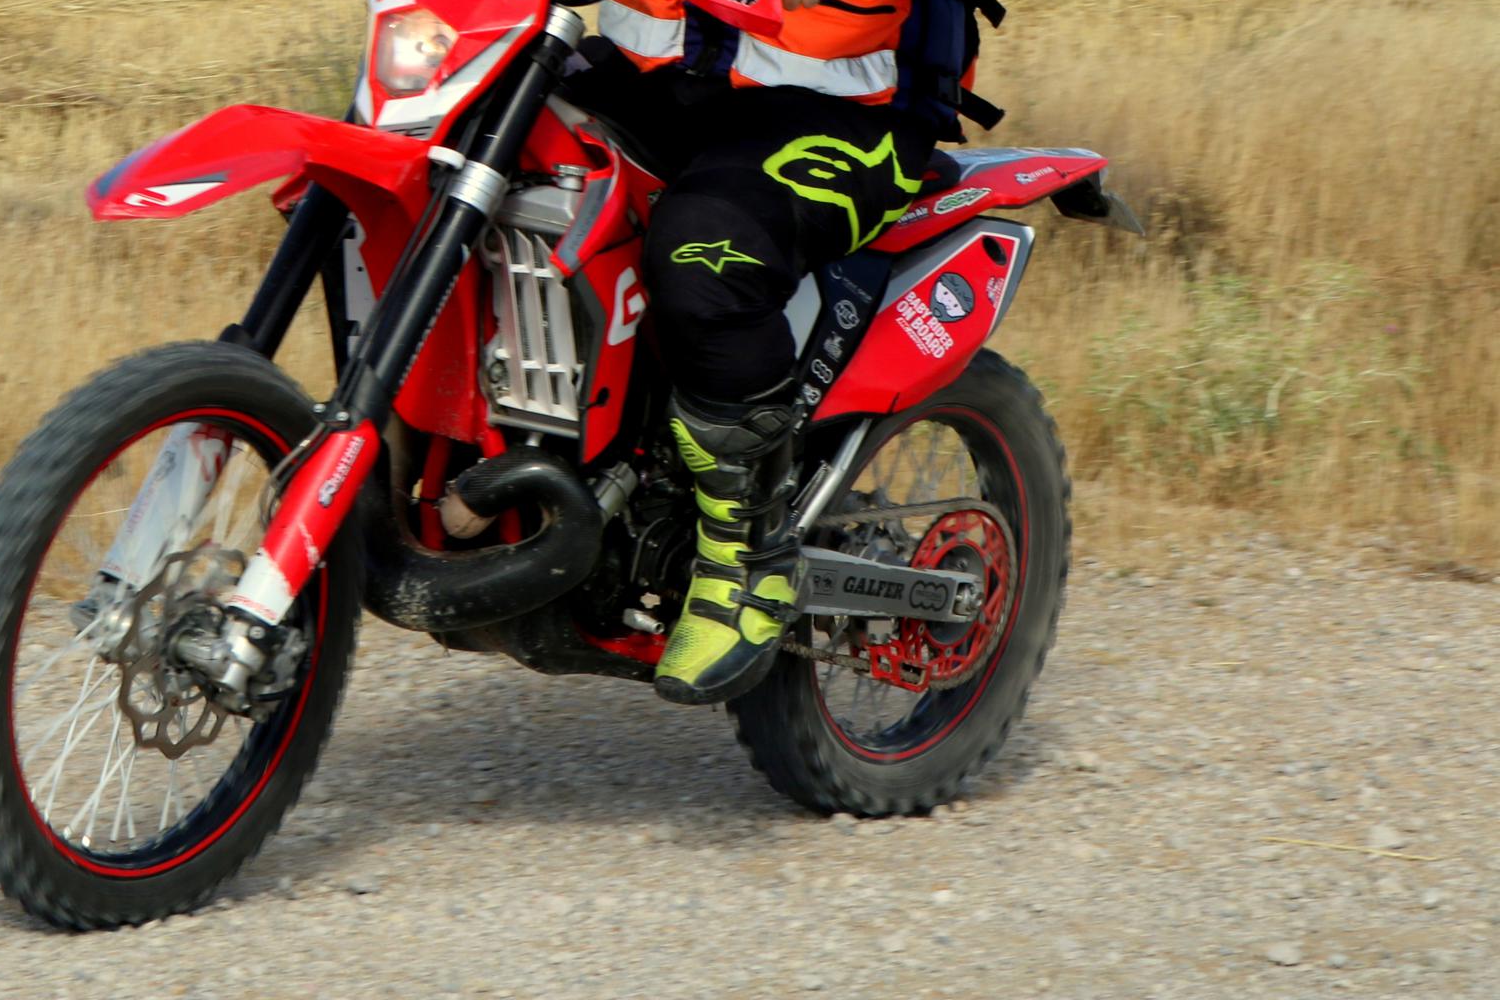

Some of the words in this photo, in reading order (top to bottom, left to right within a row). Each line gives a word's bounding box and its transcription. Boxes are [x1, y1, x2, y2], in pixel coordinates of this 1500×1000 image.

[896, 300, 916, 321] ON
[910, 317, 946, 359] BOARD
[904, 290, 932, 319] BABY
[927, 316, 955, 351] RIDER
[843, 575, 905, 601] GALFER
